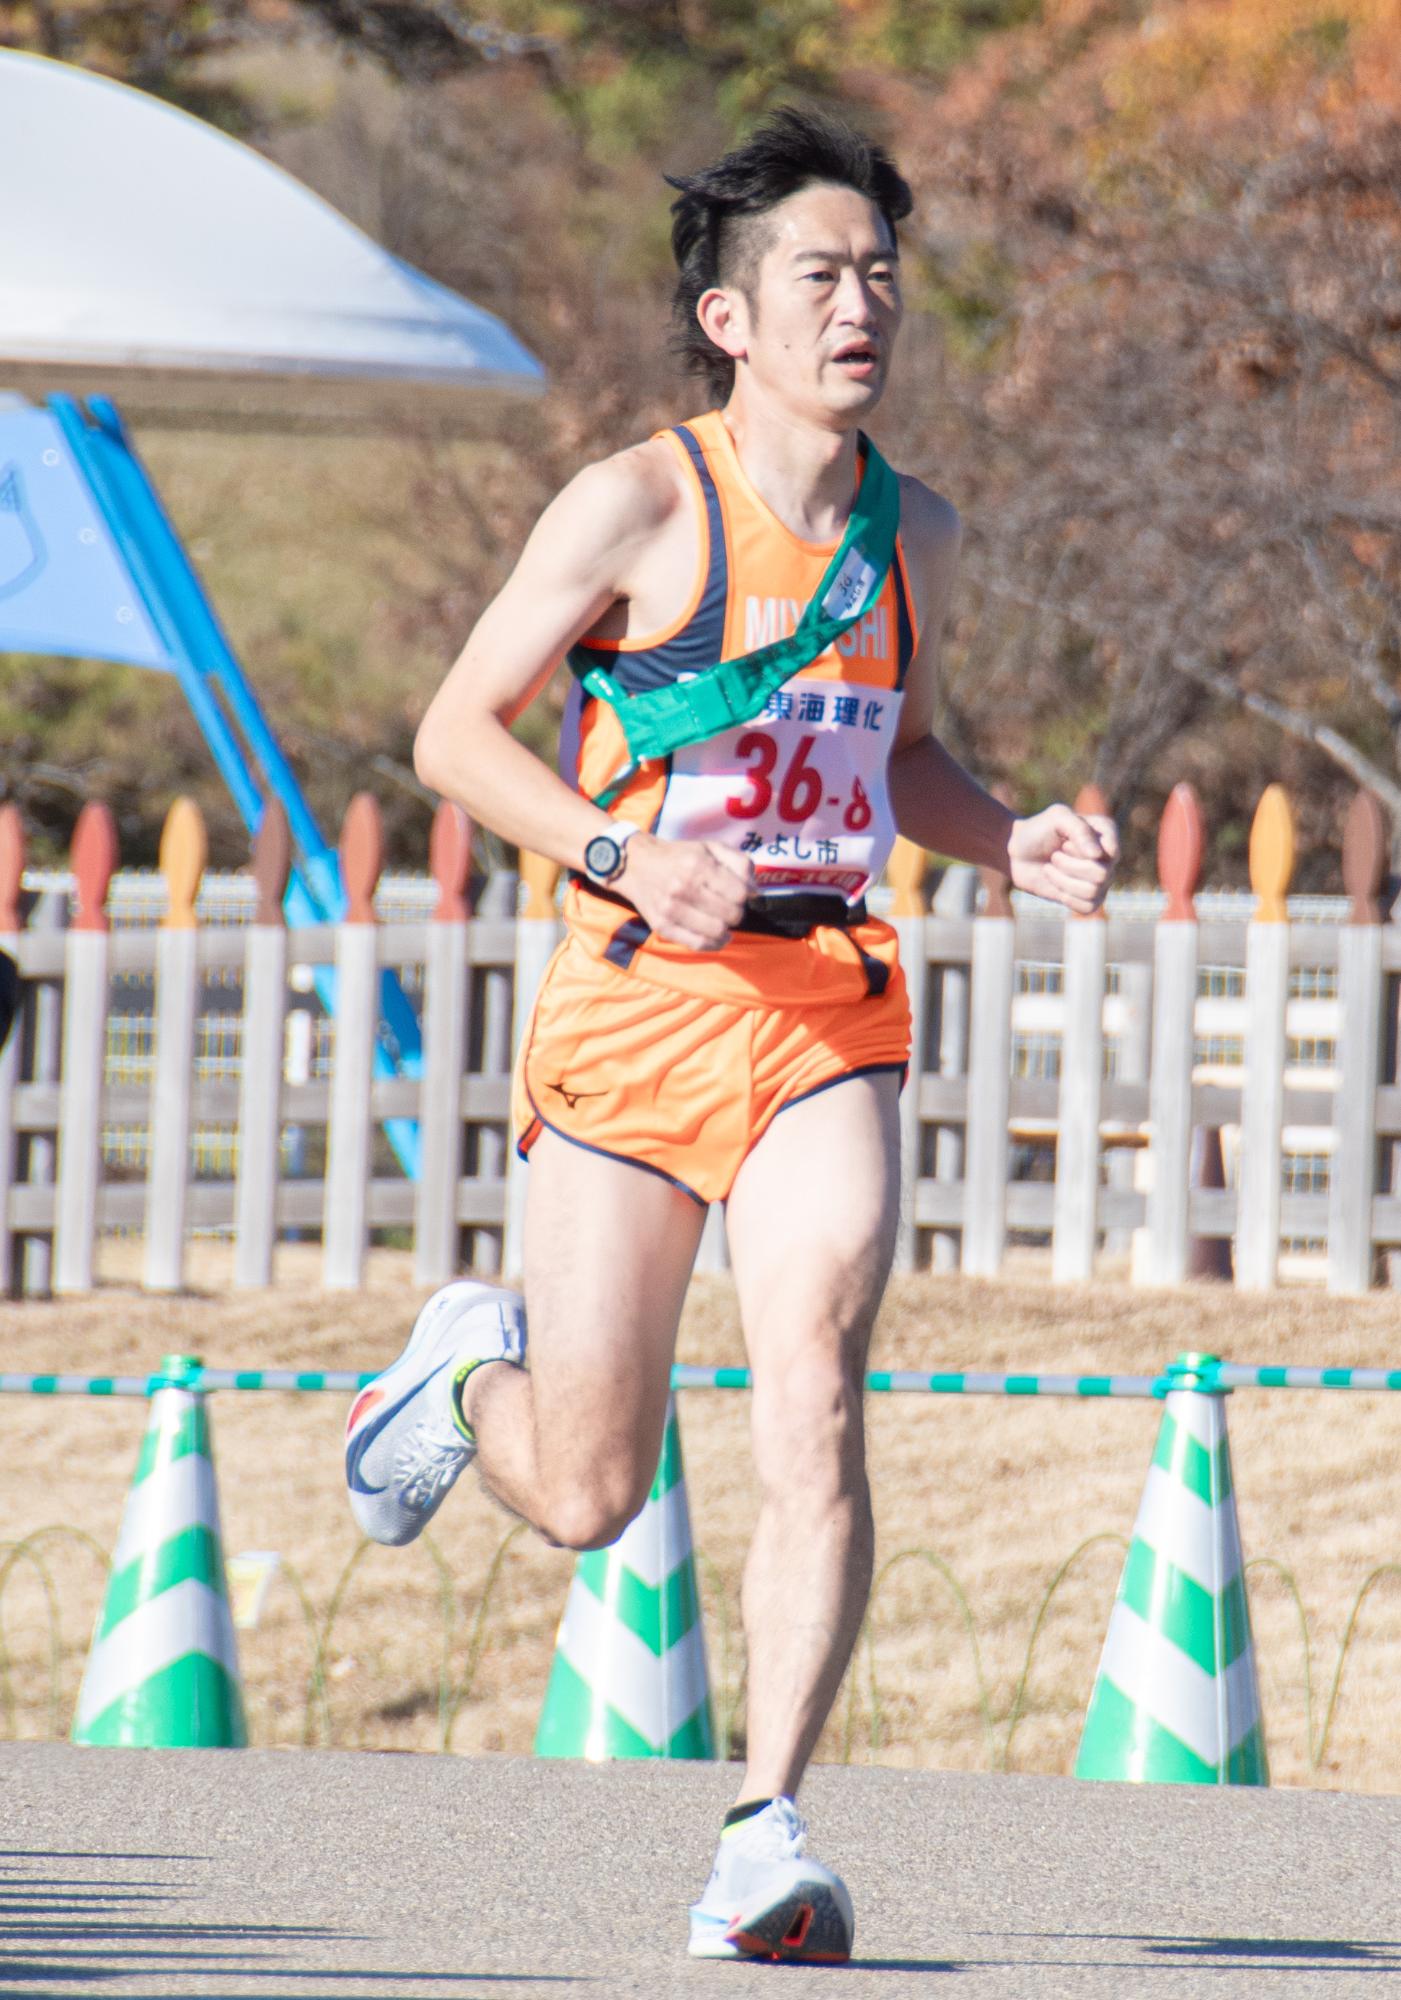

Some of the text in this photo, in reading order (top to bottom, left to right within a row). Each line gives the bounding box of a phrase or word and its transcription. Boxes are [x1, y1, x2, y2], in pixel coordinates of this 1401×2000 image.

[744, 596, 887, 660] MIYSHI
[765, 691, 884, 731] 東海理化
[740, 831, 839, 864] みよし市
